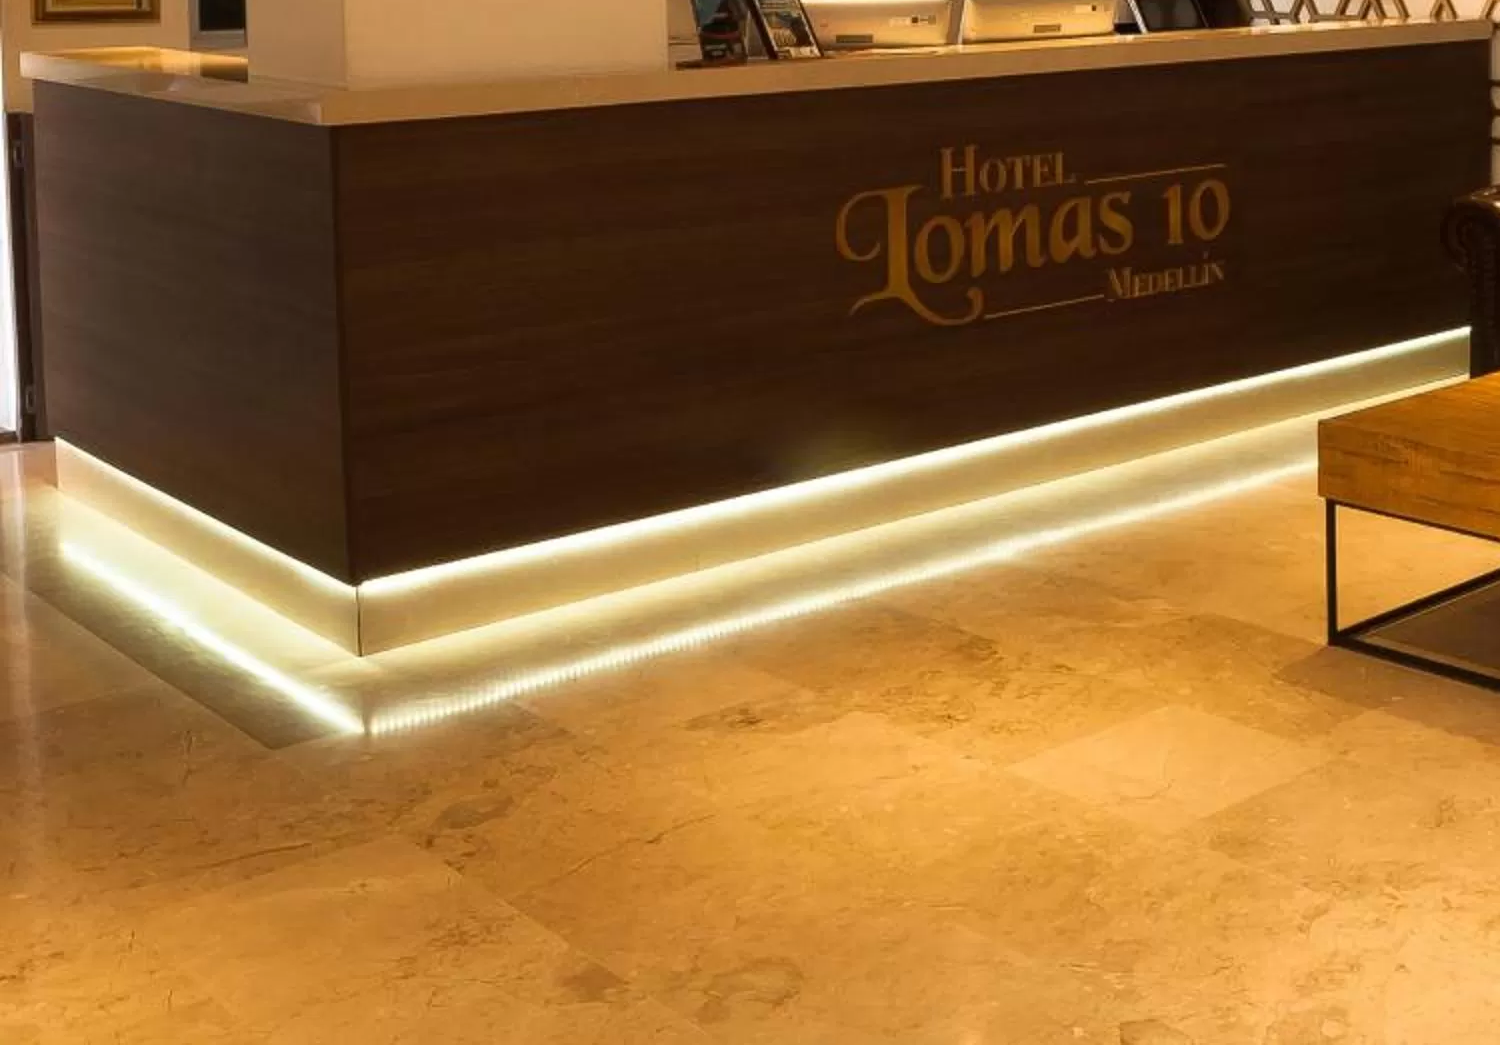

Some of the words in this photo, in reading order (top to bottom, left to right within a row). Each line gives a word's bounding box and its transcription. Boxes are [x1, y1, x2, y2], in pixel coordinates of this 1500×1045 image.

[940, 144, 1077, 199] HOTEL
[836, 184, 1134, 326] Lomas
[1163, 179, 1231, 246] 10
